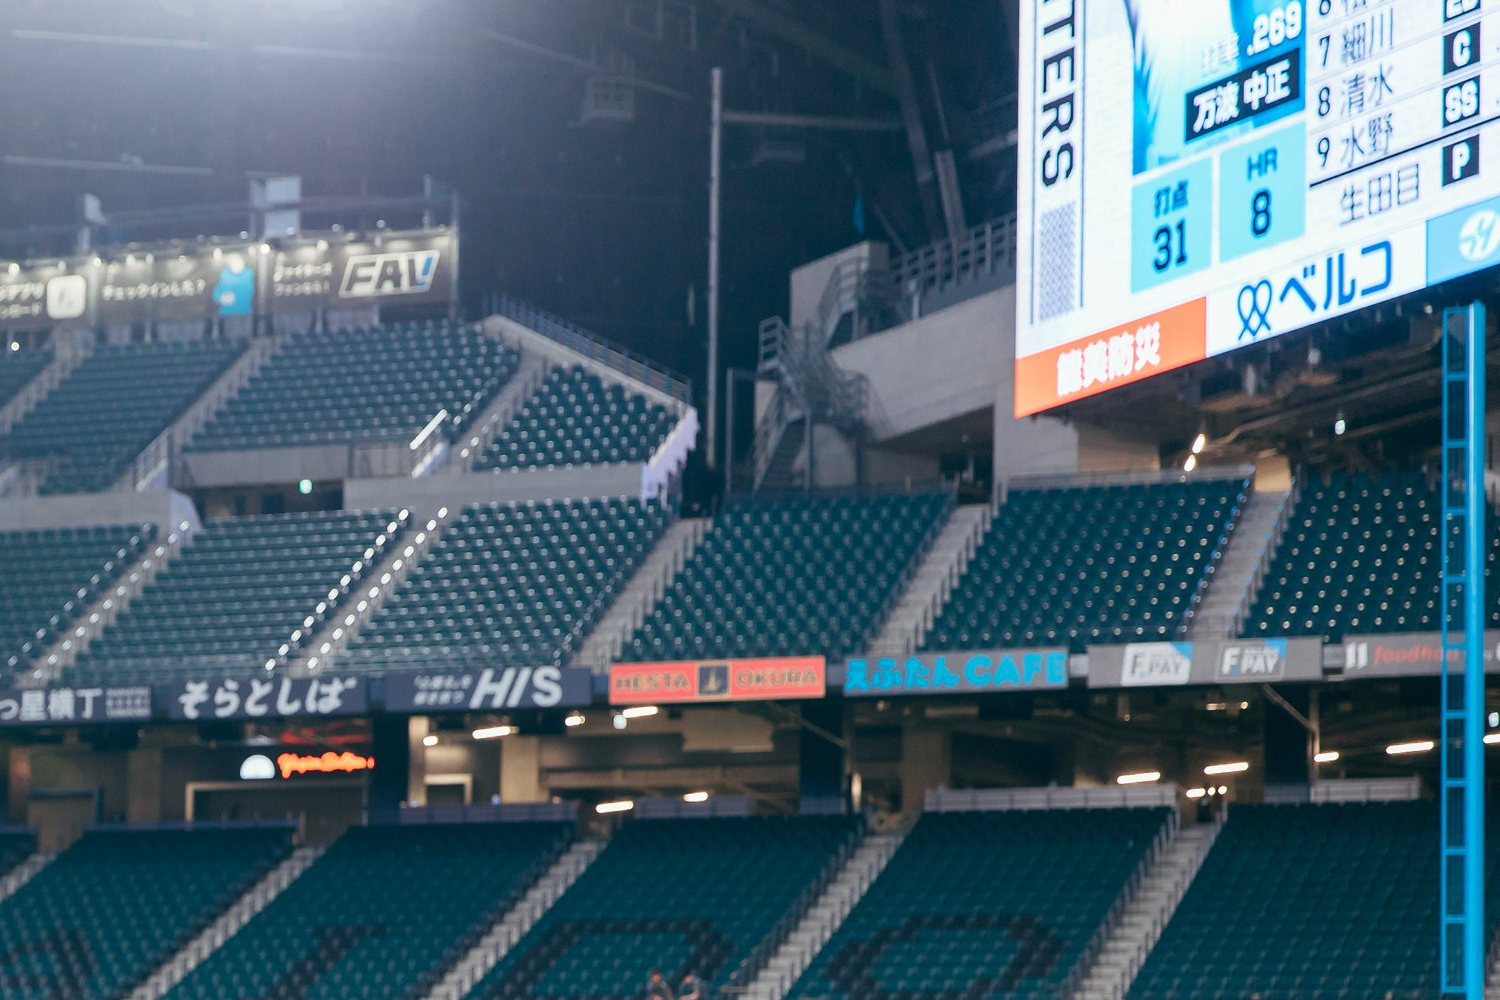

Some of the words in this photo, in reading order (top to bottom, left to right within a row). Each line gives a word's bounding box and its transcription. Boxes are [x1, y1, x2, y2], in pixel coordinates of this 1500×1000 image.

[1319, 34, 1331, 67] 7
[1341, 7, 1394, 63] 細川
[1452, 30, 1471, 68] C
[1243, 58, 1291, 111] 中正
[1318, 86, 1331, 117] 8
[1340, 63, 1394, 117] 清水
[1444, 79, 1479, 124] SS
[1247, 147, 1278, 182] HR
[1317, 137, 1331, 168] 9
[1340, 112, 1394, 168] 水野
[1451, 140, 1471, 180] P
[1154, 179, 1189, 218] 打点
[1251, 188, 1272, 238] 8
[1340, 163, 1420, 226] 生田目
[1153, 218, 1188, 273] 31
[1279, 240, 1392, 312] ベルコ
[468, 665, 563, 710] HIS
[615, 672, 690, 693] HESTA
[735, 669, 819, 688] OKURA
[964, 651, 1067, 685] CAFE
[178, 676, 358, 720] そらとしば
